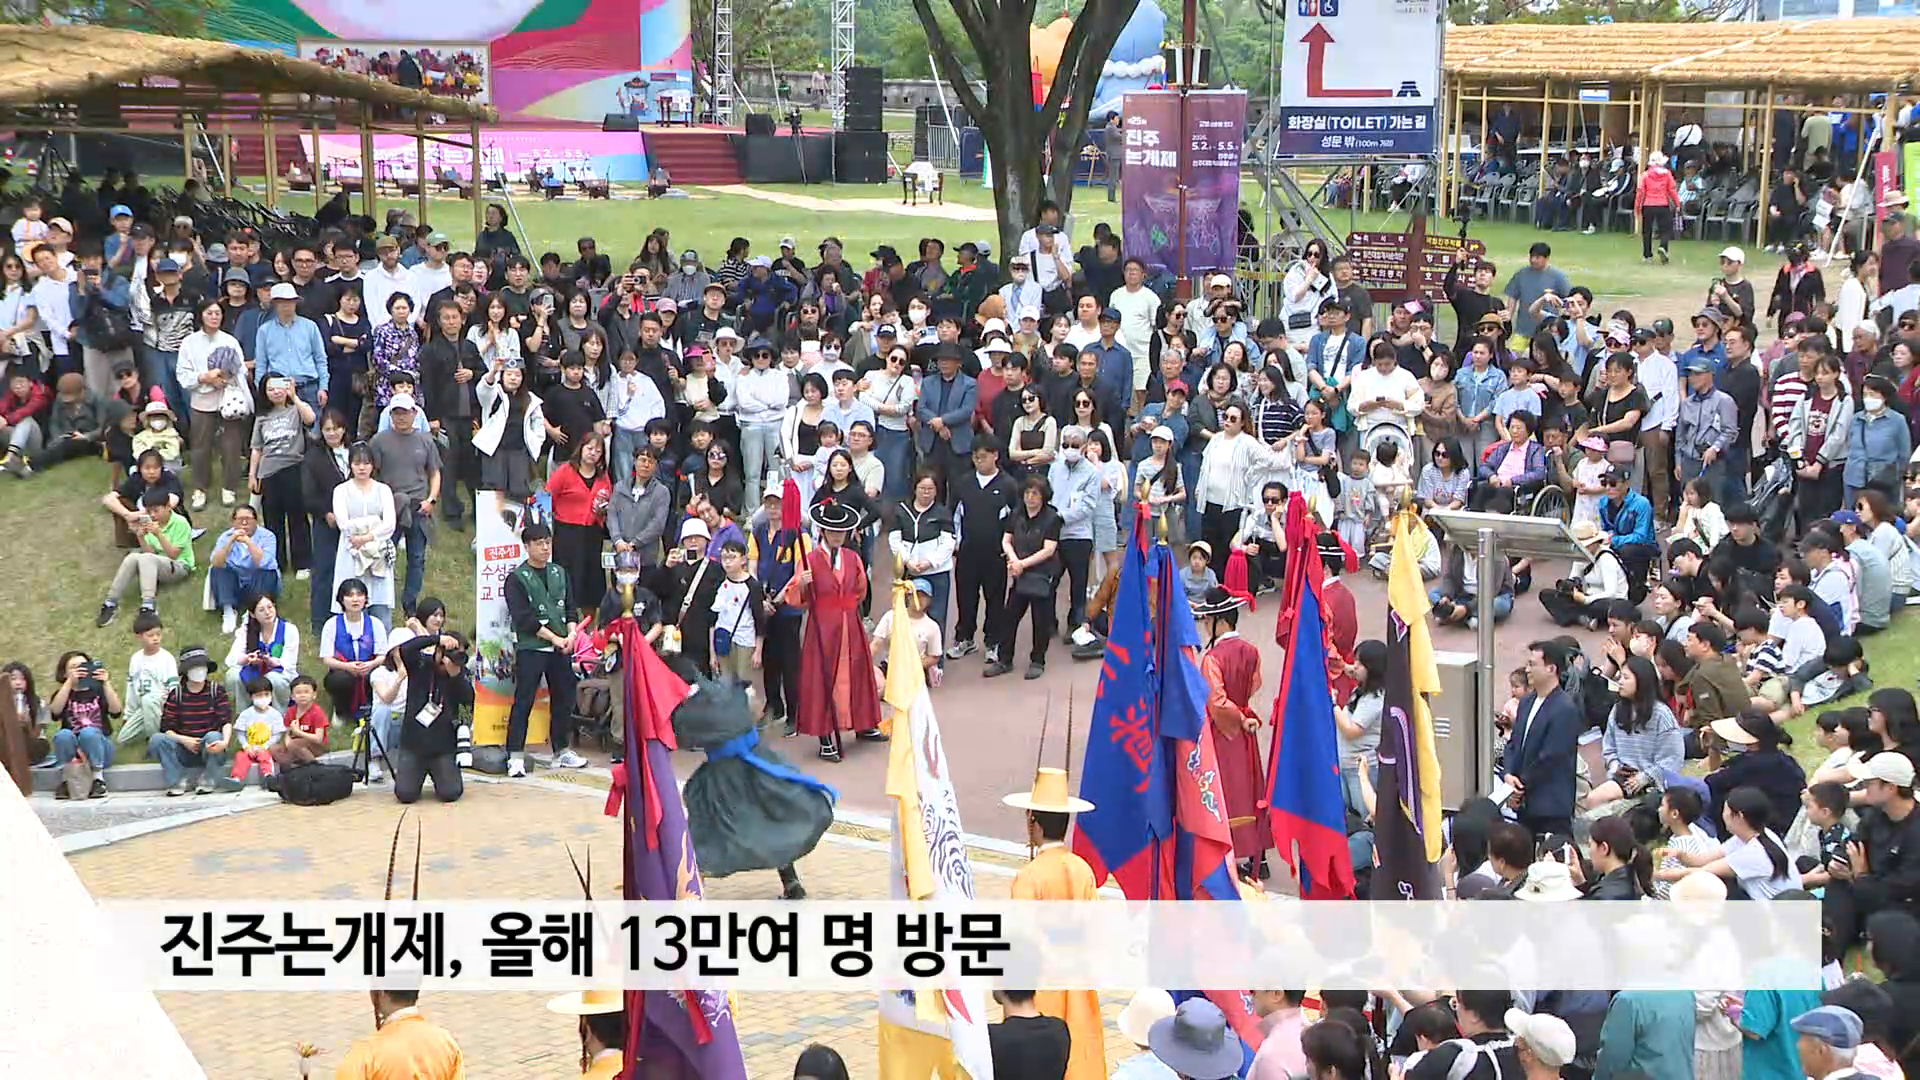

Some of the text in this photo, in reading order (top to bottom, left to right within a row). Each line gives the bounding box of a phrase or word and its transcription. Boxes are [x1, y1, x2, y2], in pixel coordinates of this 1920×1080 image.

[1287, 115, 1426, 130] 화장실(TOILET) 가는 길
[1125, 129, 1160, 147] 진주
[1321, 136, 1342, 147] 성문
[1125, 148, 1177, 168] 논개제
[1426, 236, 1468, 248] 국립진주박물
[489, 544, 516, 559] 진주성
